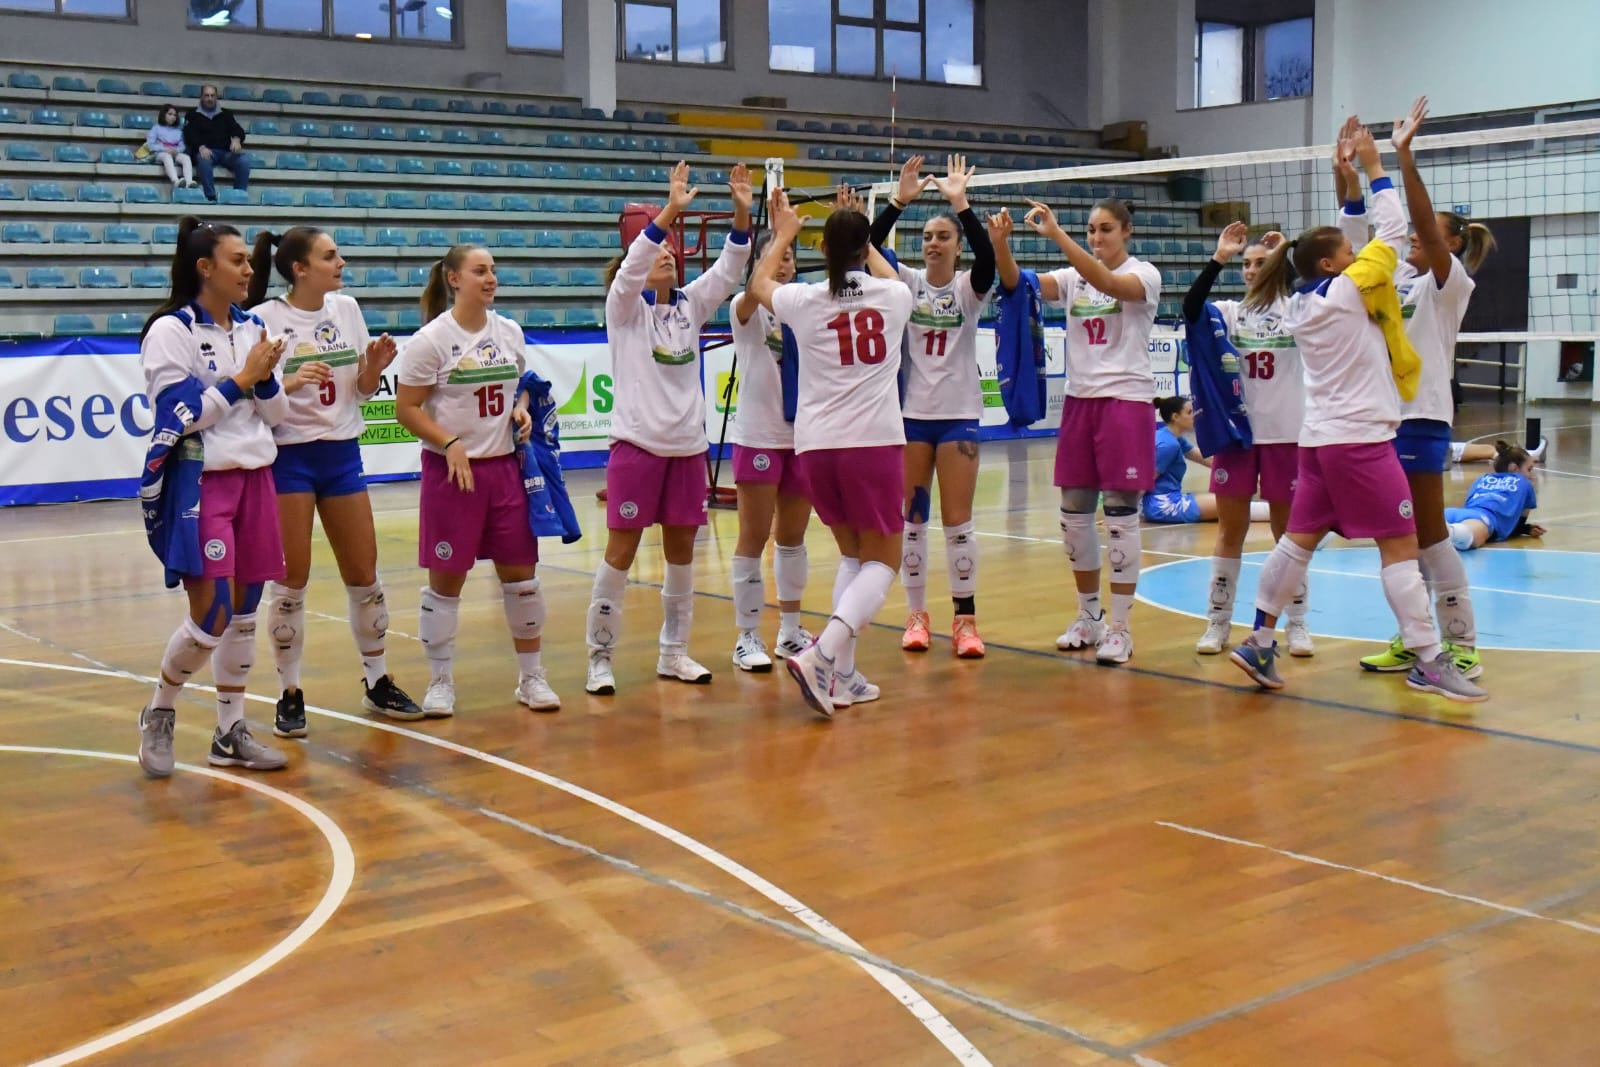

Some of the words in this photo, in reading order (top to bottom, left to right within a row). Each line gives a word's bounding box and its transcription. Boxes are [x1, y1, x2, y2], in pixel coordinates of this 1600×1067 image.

[827, 309, 887, 366] 18
[923, 330, 947, 356] 11
[1082, 318, 1107, 345] 12
[318, 341, 348, 353] TRAINA
[208, 359, 217, 372] 4
[1244, 351, 1275, 380] 13
[473, 384, 504, 418] 15
[4, 393, 156, 443] esec
